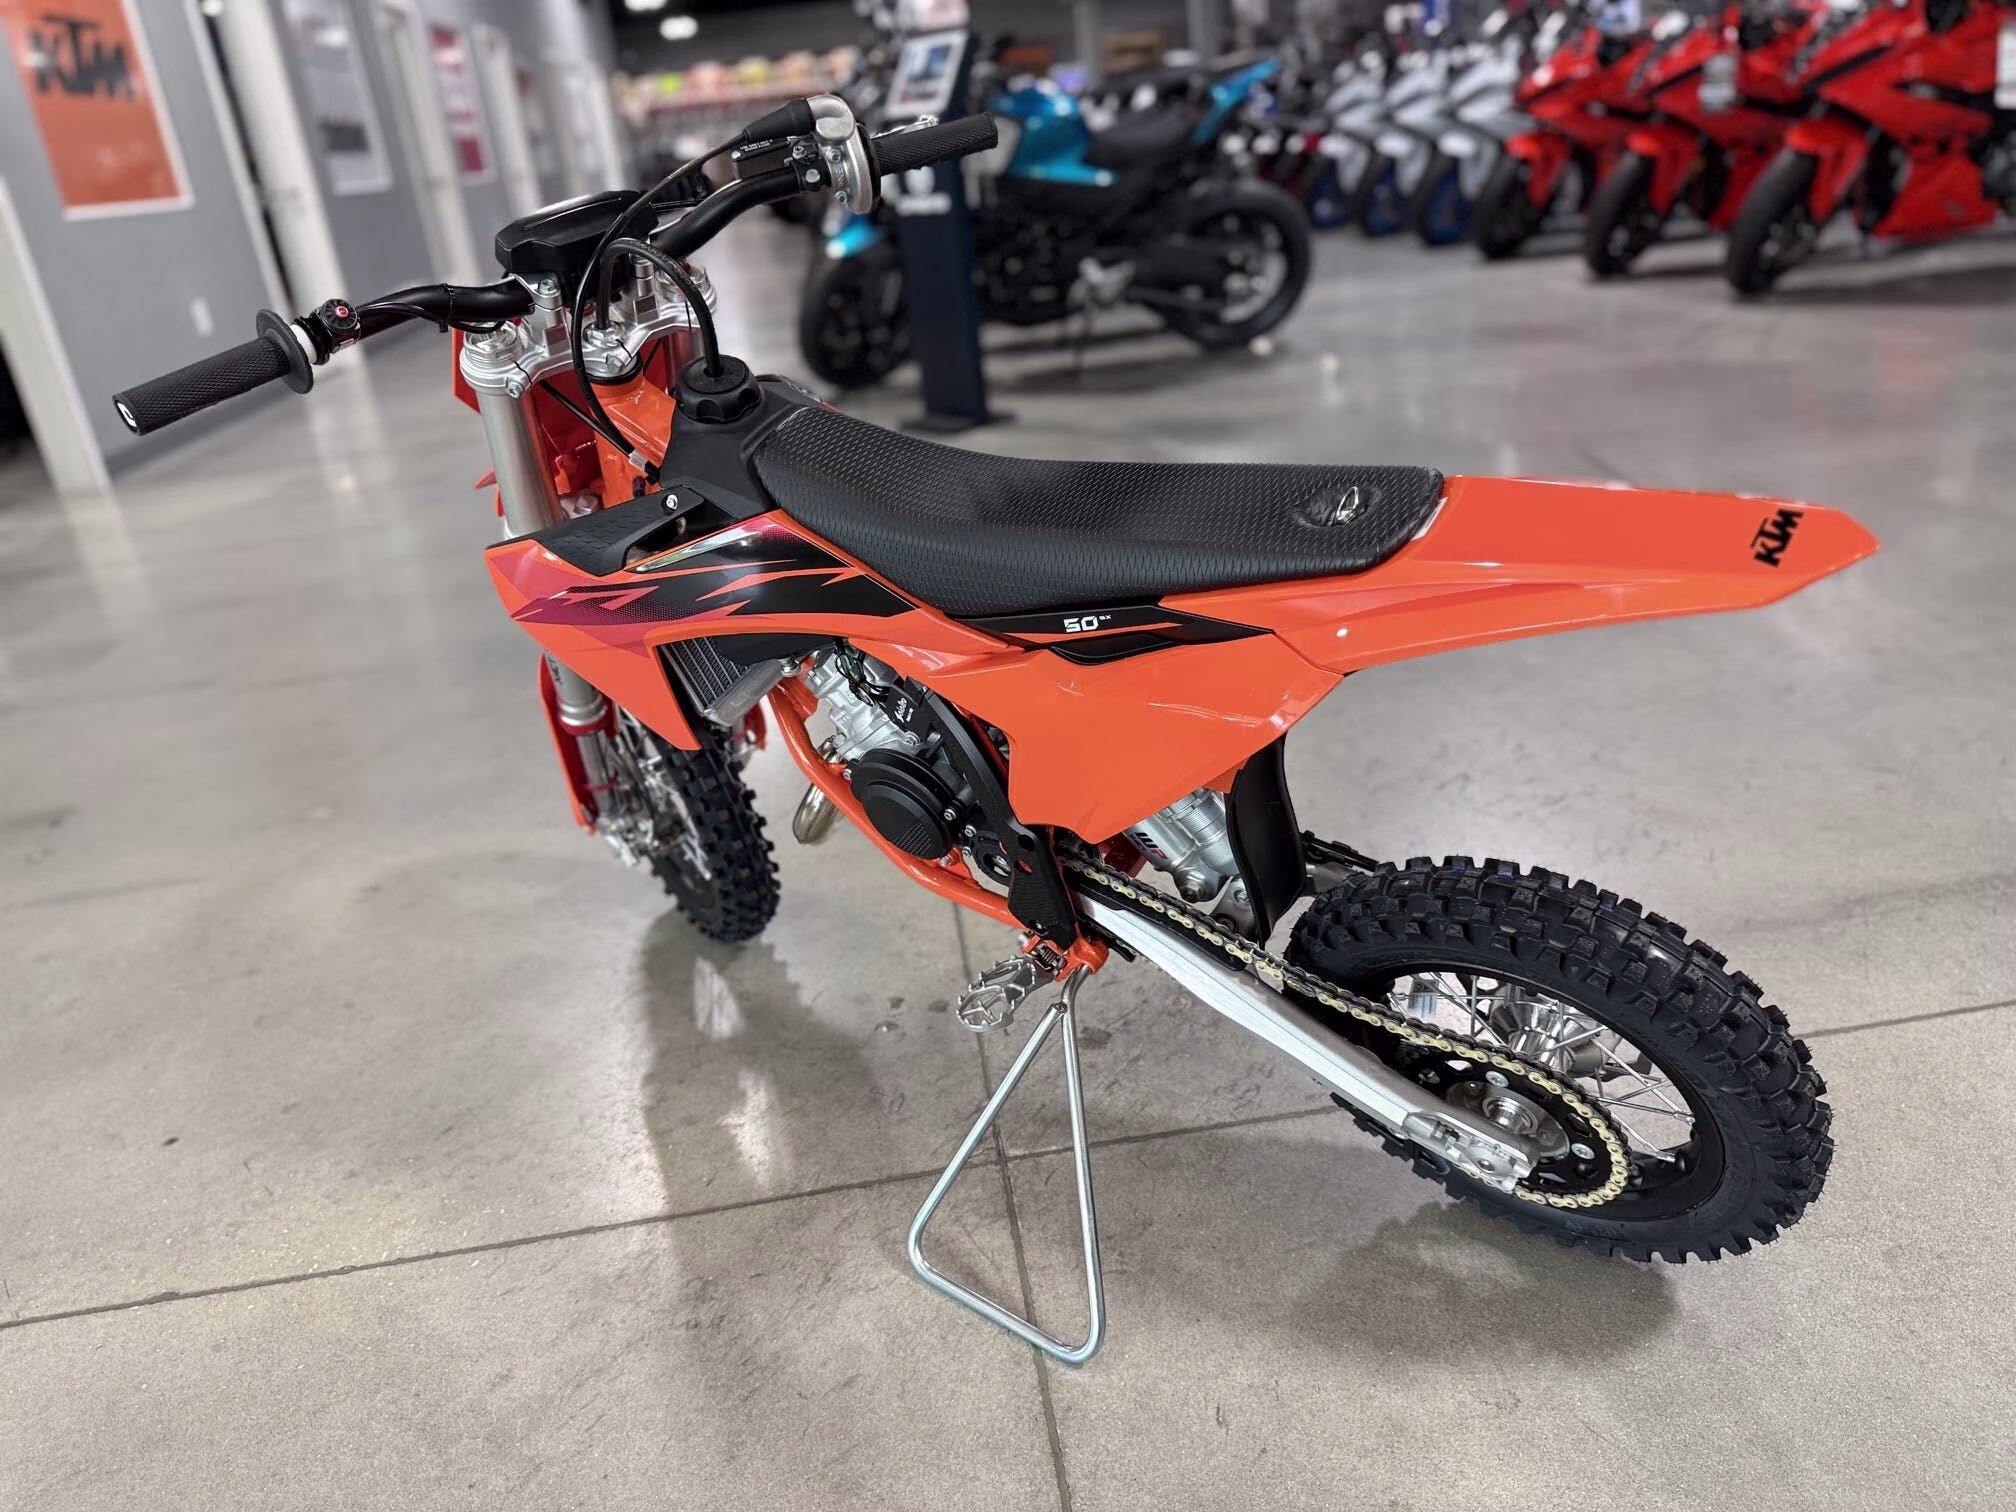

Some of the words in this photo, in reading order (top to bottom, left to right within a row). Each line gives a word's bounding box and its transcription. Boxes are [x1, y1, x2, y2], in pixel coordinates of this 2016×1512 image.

[30, 13, 134, 101] KTM
[1750, 509, 1804, 568] KTM
[1063, 616, 1099, 633] 50
